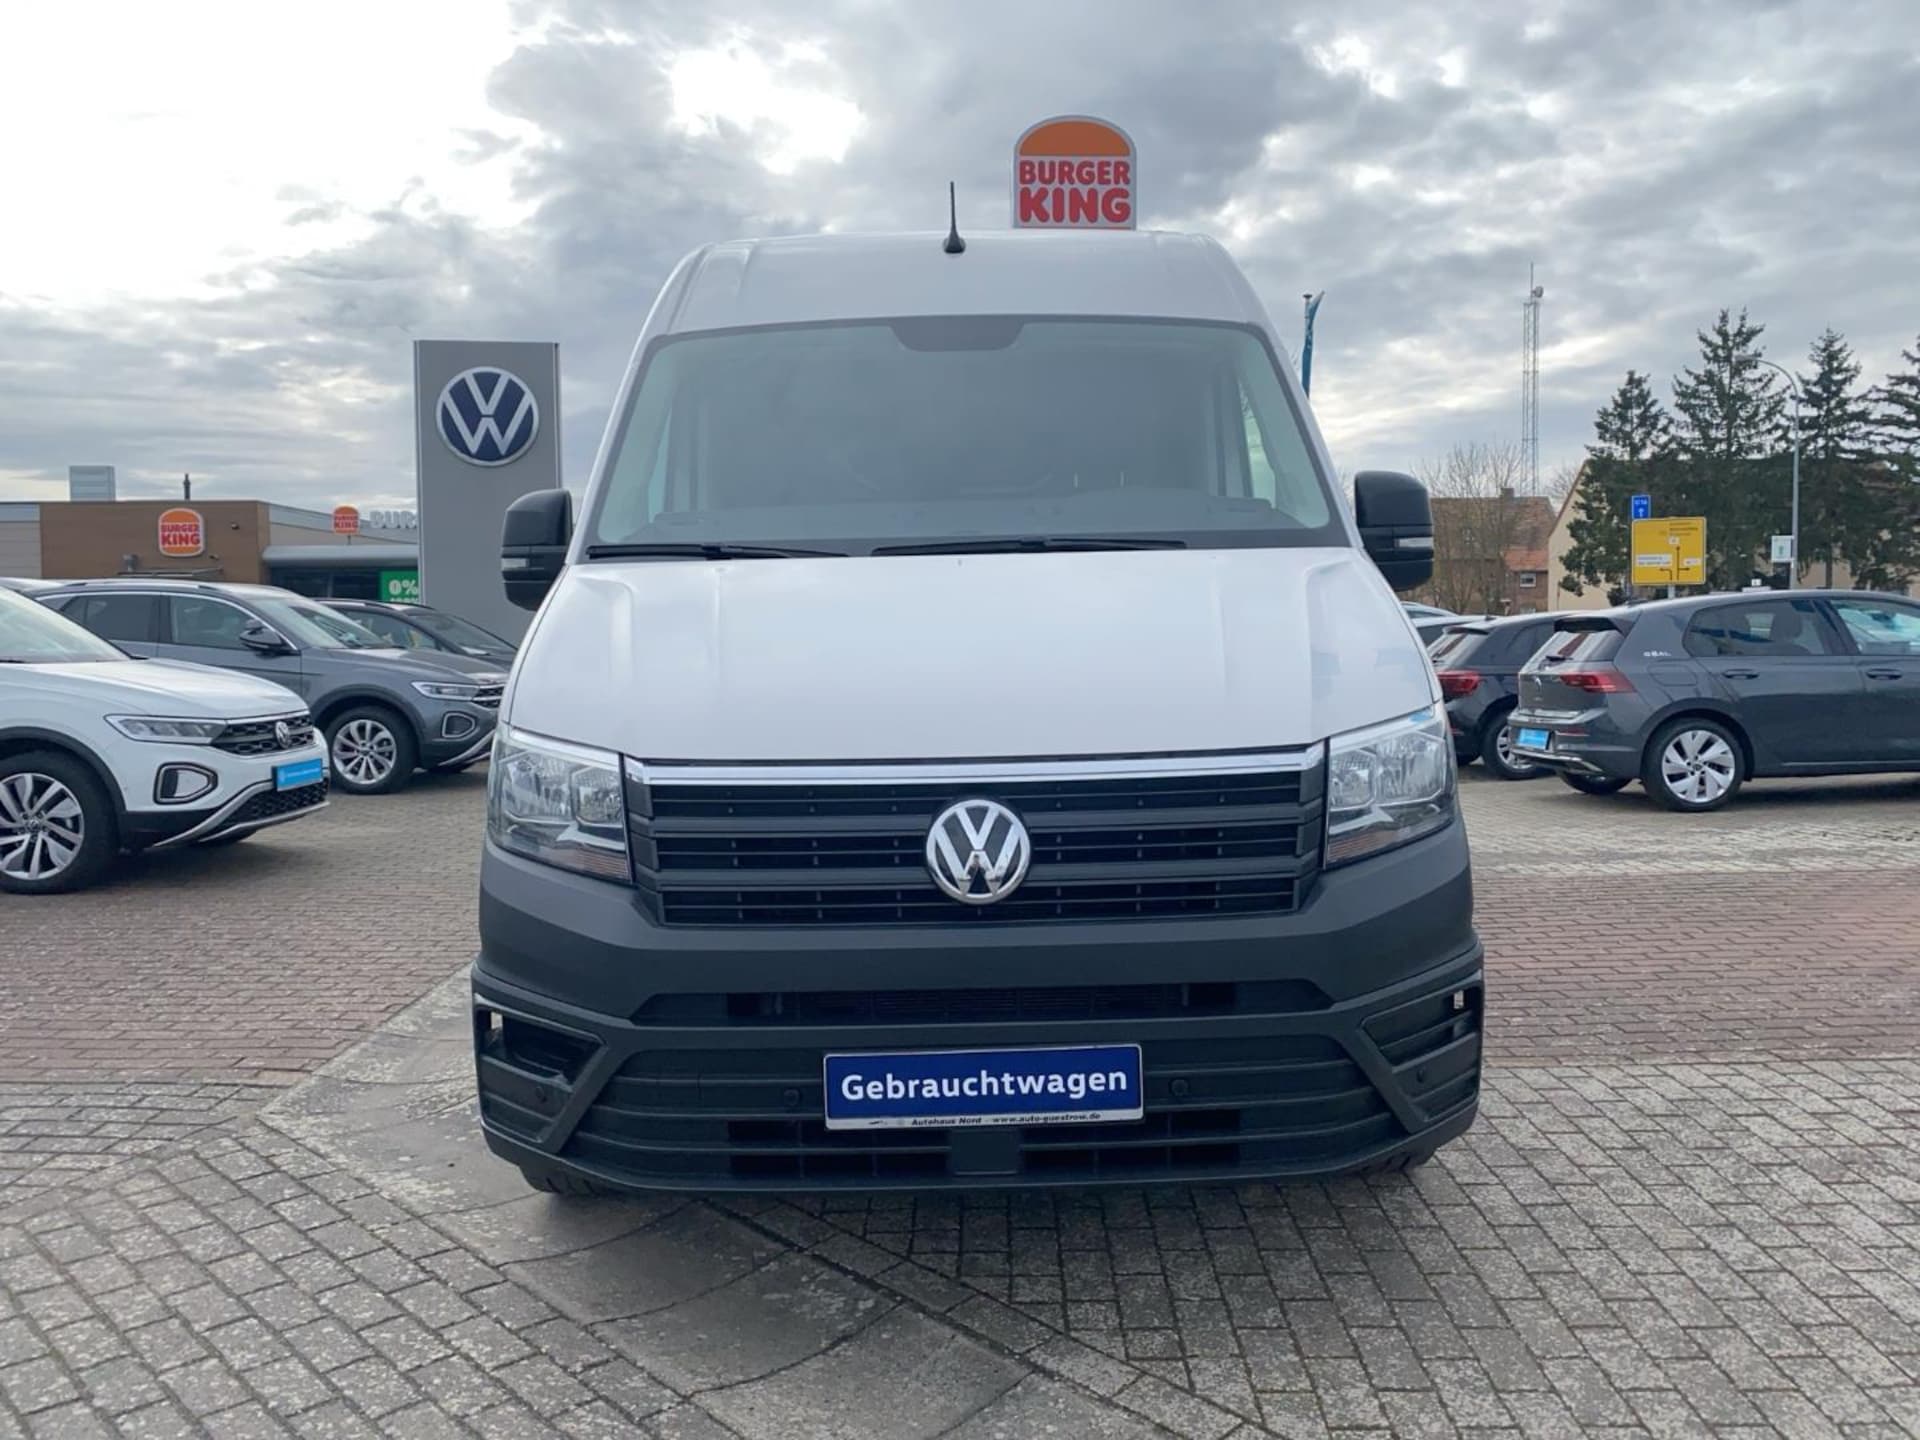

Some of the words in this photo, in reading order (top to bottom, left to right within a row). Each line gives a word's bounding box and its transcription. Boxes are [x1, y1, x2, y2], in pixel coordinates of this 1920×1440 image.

[1019, 160, 1130, 185] BURGER
[1019, 187, 1131, 223] KING
[161, 523, 200, 533] BURGER
[161, 533, 201, 546] KING
[841, 1069, 1128, 1101] Gebrauchtwagen
[911, 1118, 956, 1127] Autohaus
[958, 1116, 982, 1125] Nord
